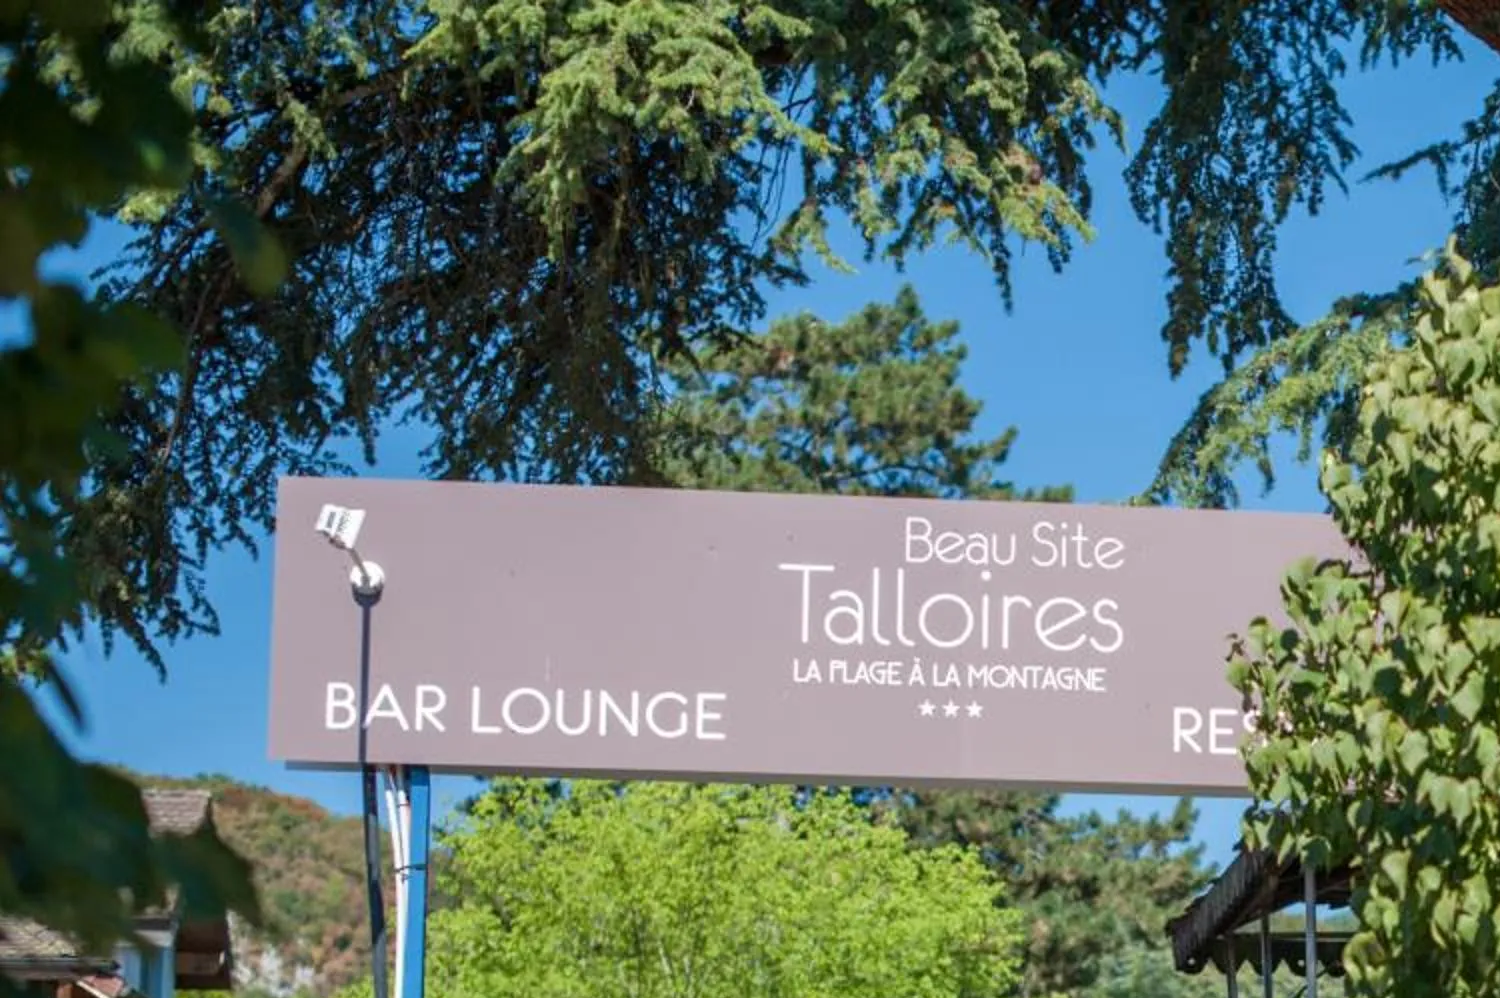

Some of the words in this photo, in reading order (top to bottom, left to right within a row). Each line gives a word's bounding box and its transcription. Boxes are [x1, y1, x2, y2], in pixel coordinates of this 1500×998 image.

[905, 516, 1016, 566] Beau
[1031, 520, 1126, 570] Site
[777, 562, 1124, 653] Talloires
[792, 658, 823, 683] LA
[829, 660, 904, 686] PLAGE
[908, 656, 926, 687] À
[932, 662, 961, 688] LA
[967, 664, 1108, 692] MONTAGNE
[325, 681, 446, 732] BAR
[470, 684, 728, 740] LOUNGE
